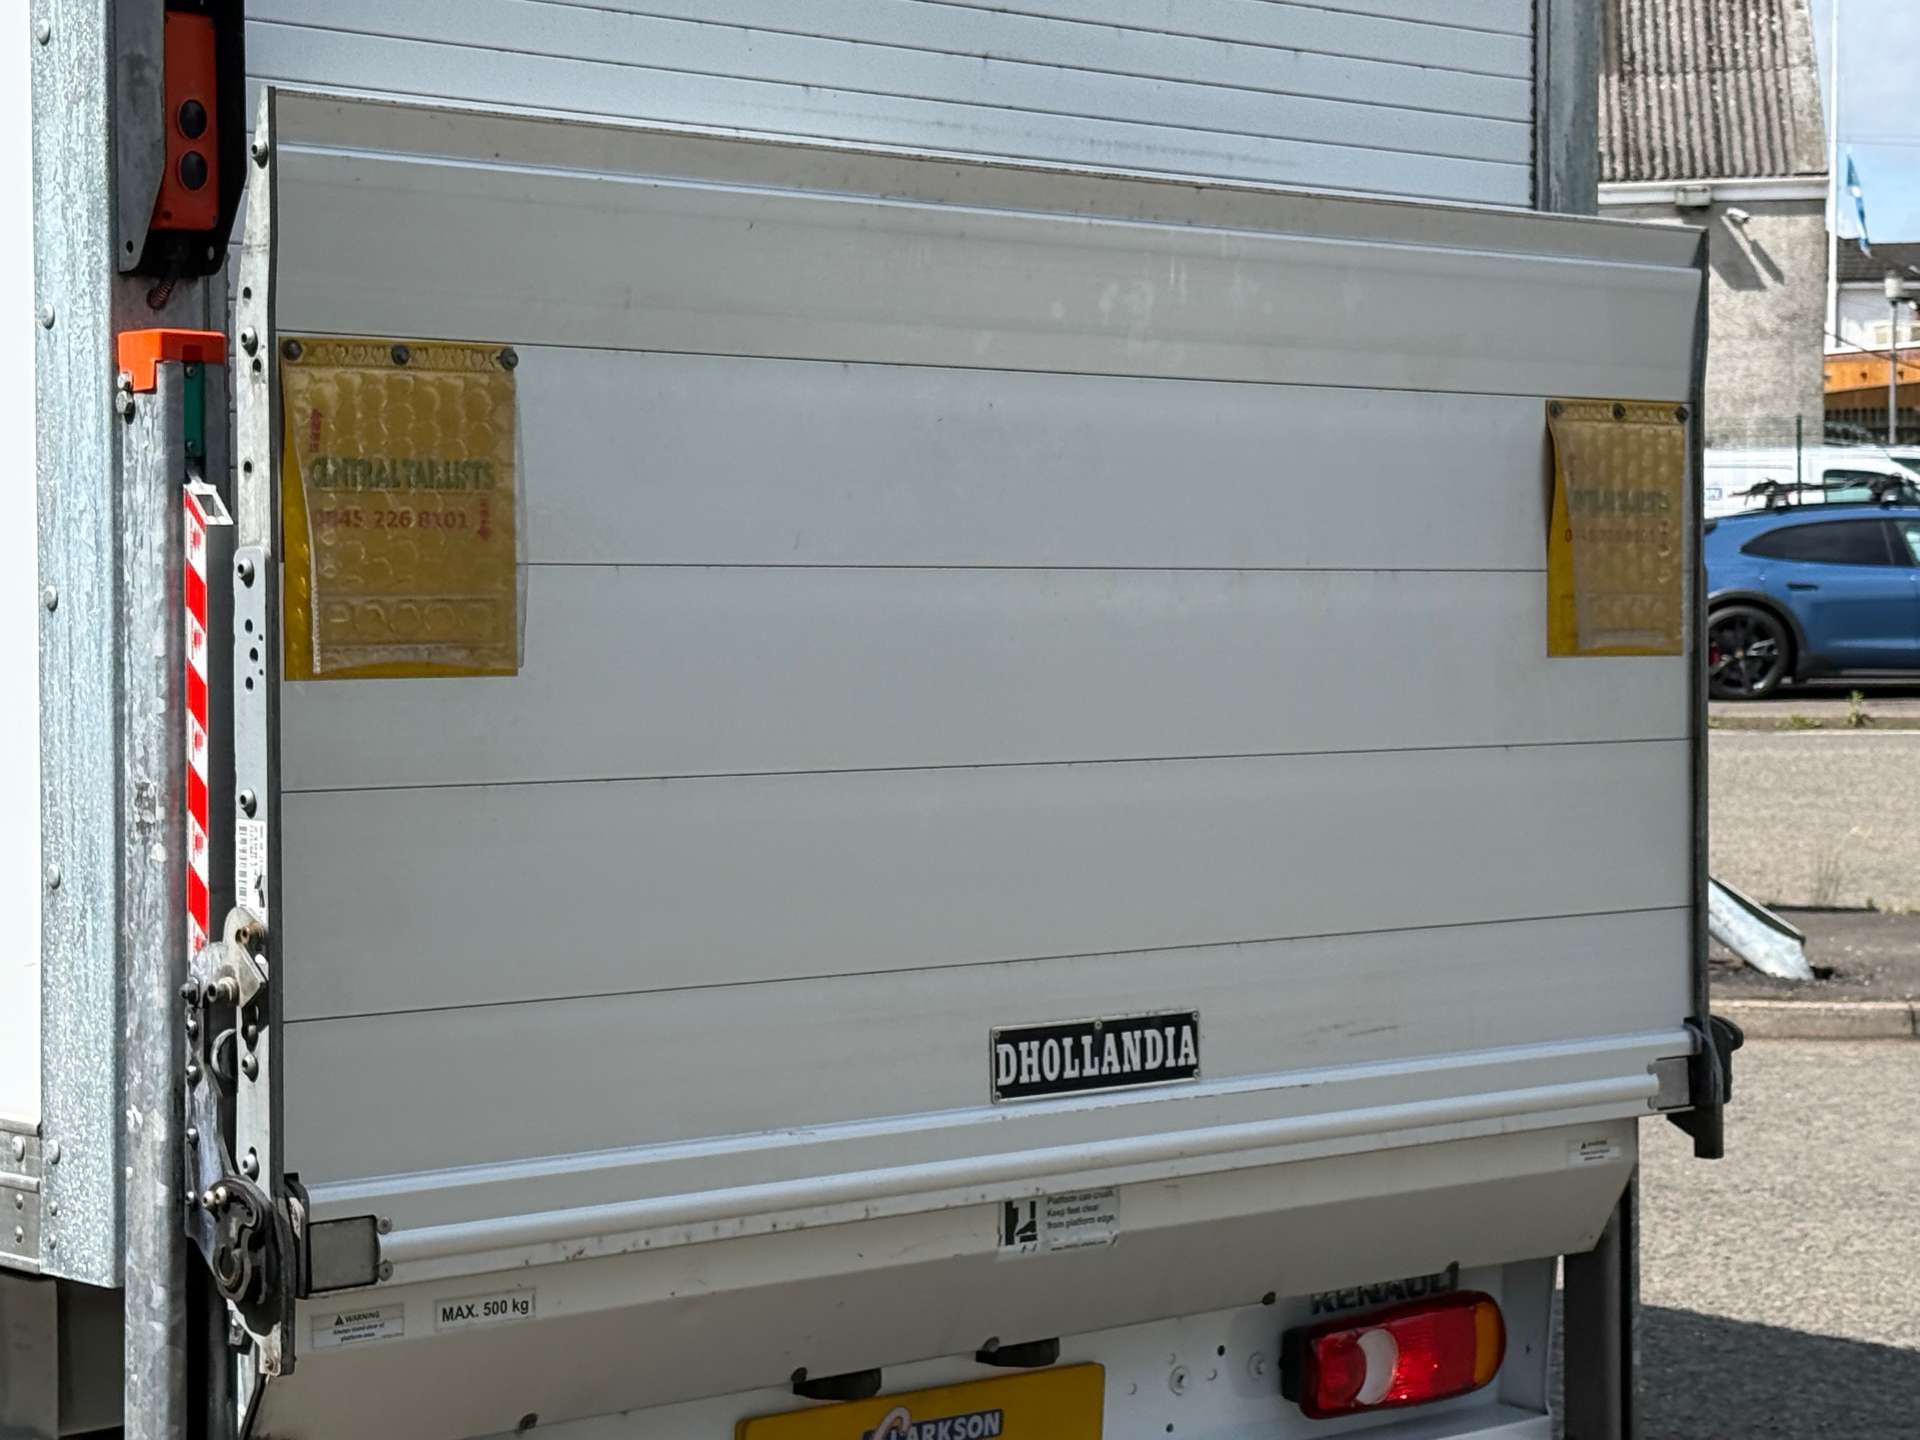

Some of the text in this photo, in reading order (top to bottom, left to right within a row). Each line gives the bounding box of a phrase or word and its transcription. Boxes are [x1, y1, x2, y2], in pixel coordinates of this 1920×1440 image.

[373, 510, 412, 529] 226
[996, 1025, 1198, 1087] DHOLLANDIA
[441, 1298, 529, 1323] MAX. 500 kg
